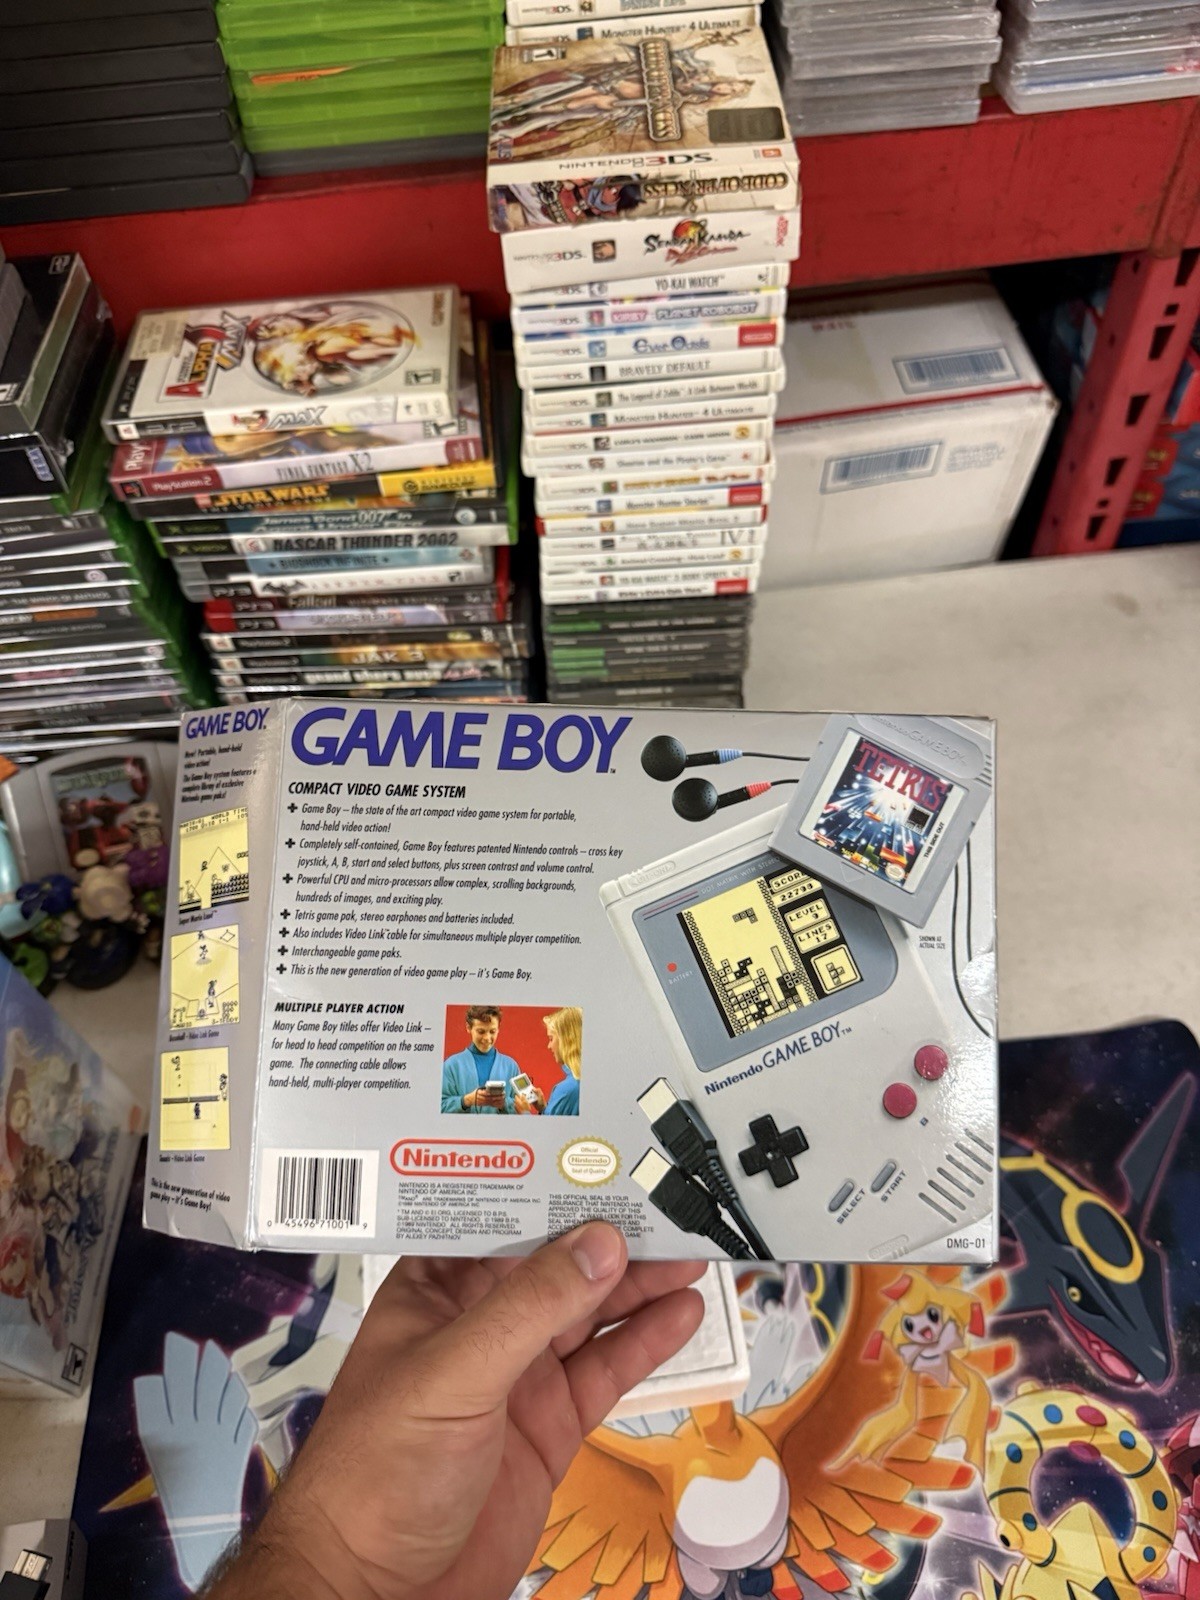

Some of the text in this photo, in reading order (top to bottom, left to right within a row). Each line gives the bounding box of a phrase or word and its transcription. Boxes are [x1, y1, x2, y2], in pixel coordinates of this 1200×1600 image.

[601, 29, 642, 39] MONSTER
[689, 22, 695, 30] 4
[698, 19, 741, 30] ULTIMATE
[559, 153, 713, 170] NINTENDO 3DS
[741, 173, 788, 194] CODE
[666, 360, 711, 373] DEFAULT
[214, 489, 268, 507] STAR
[274, 483, 331, 502] WARS
[274, 532, 458, 551] NASCAR THUNDER 2002
[186, 713, 232, 739] GAME
[291, 707, 489, 769] GAME
[853, 741, 948, 811] TETRIS
[288, 782, 466, 799] COMPACT VIDEO GAME SYSTEM
[300, 820, 391, 832] hand-held video action!
[300, 838, 623, 859] Completely self-contained, Game Boy features patented Nintendo controls cross key
[297, 874, 577, 893] Powerful CPU and micro-processors allow complex, scrolling backgrounds,
[295, 910, 514, 925] Tetris game pak, stereo earphones and batteries included.
[789, 904, 822, 921] LEVEL
[798, 924, 831, 942] LINES
[816, 933, 827, 942] 17
[292, 946, 402, 960] Interchangeable game paks.
[291, 964, 532, 981] This is the new generation of video game play it's Game Boy.
[668, 970, 694, 985] BATTERY
[275, 1002, 405, 1014] MULTIPLE PLAYER ACTION
[704, 1063, 763, 1095] Nintendo
[762, 1035, 811, 1068] GAME
[269, 1076, 411, 1090] hand-held, multi-player competition.
[182, 1187, 207, 1198] generation
[209, 1190, 215, 1199] of
[216, 1191, 230, 1202] video
[881, 1170, 907, 1203] START
[836, 1187, 866, 1224] SELECT
[284, 1219, 316, 1229] 45496
[320, 1219, 350, 1229] 71001
[946, 1238, 986, 1248] DMG-01
